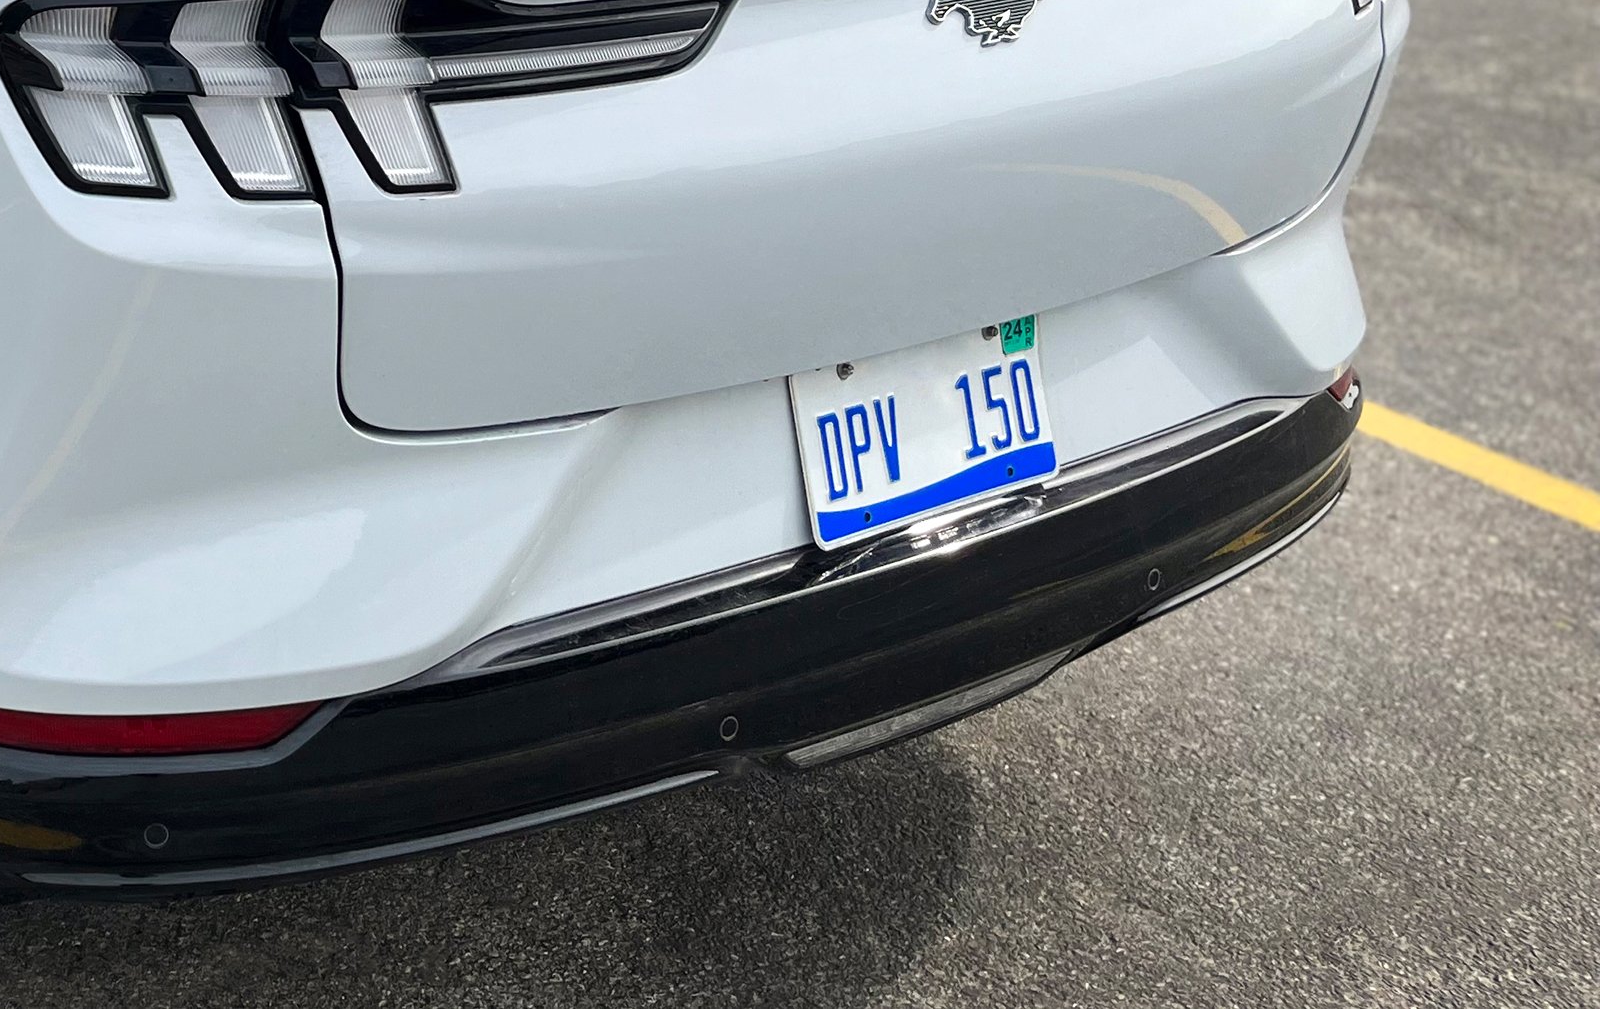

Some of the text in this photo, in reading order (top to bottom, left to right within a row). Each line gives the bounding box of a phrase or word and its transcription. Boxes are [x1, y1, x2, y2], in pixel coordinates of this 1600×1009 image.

[1002, 318, 1023, 341] 24
[816, 358, 1041, 502] DPV 150
